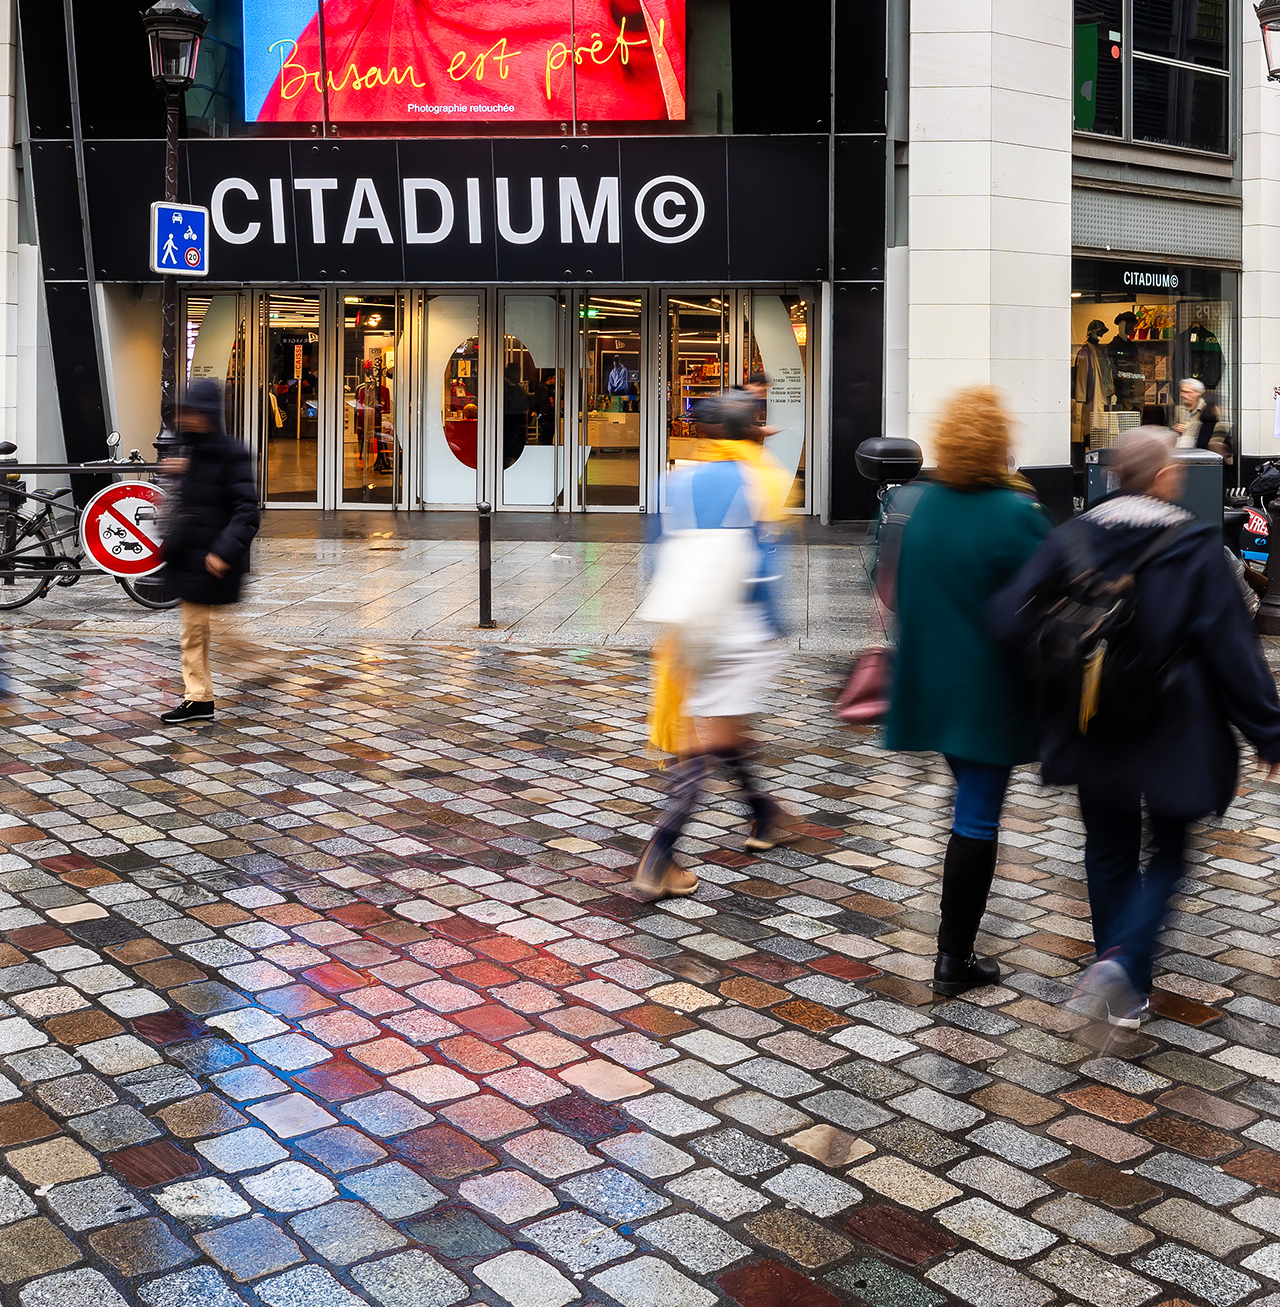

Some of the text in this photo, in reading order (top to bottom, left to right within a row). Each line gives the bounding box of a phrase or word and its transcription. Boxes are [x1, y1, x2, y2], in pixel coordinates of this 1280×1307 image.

[268, 38, 425, 100] Busan
[447, 37, 522, 81] est
[545, 15, 648, 100] prêt
[407, 103, 515, 114] Photographie retouchée
[188, 253, 198, 261] 20
